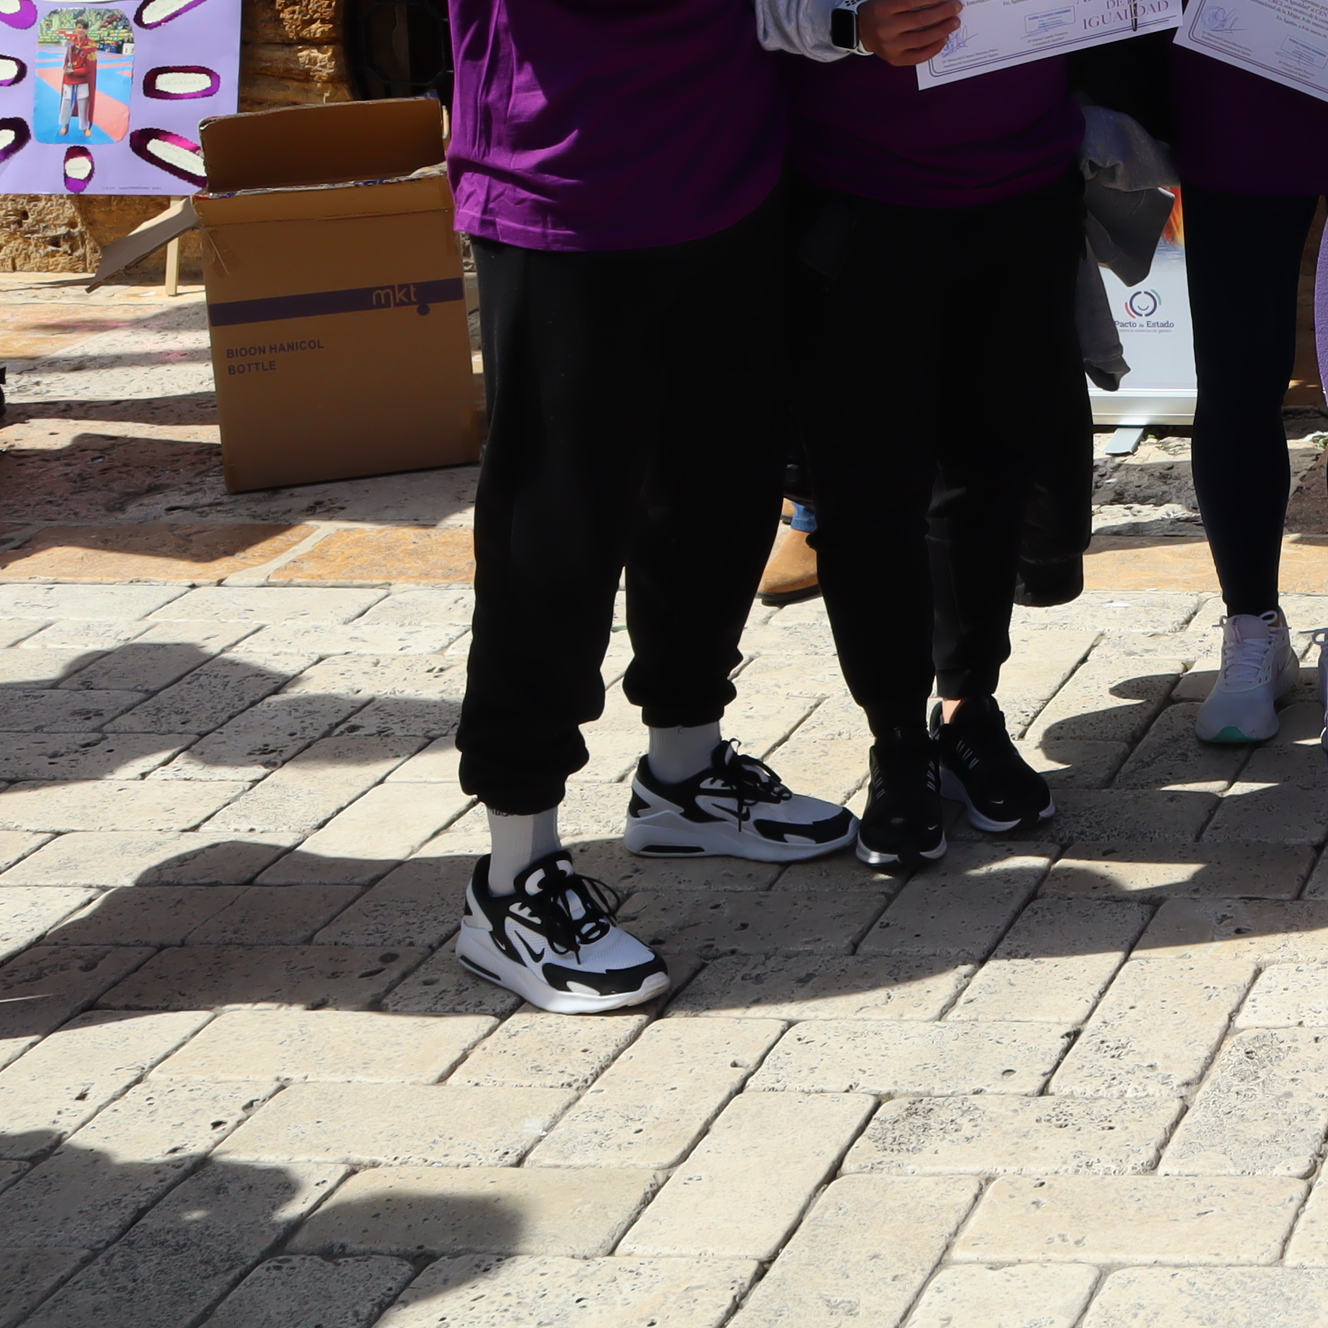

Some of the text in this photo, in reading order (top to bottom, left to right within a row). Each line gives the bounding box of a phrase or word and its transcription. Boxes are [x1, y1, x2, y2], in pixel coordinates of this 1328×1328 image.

[1082, 0, 1169, 30] IGUALDAD
[372, 284, 417, 308] mkt
[1114, 320, 1137, 328] Pacto
[1146, 320, 1174, 328] Estado
[226, 339, 324, 359] BIOON HANICOL
[228, 360, 276, 376] BOTTLE
